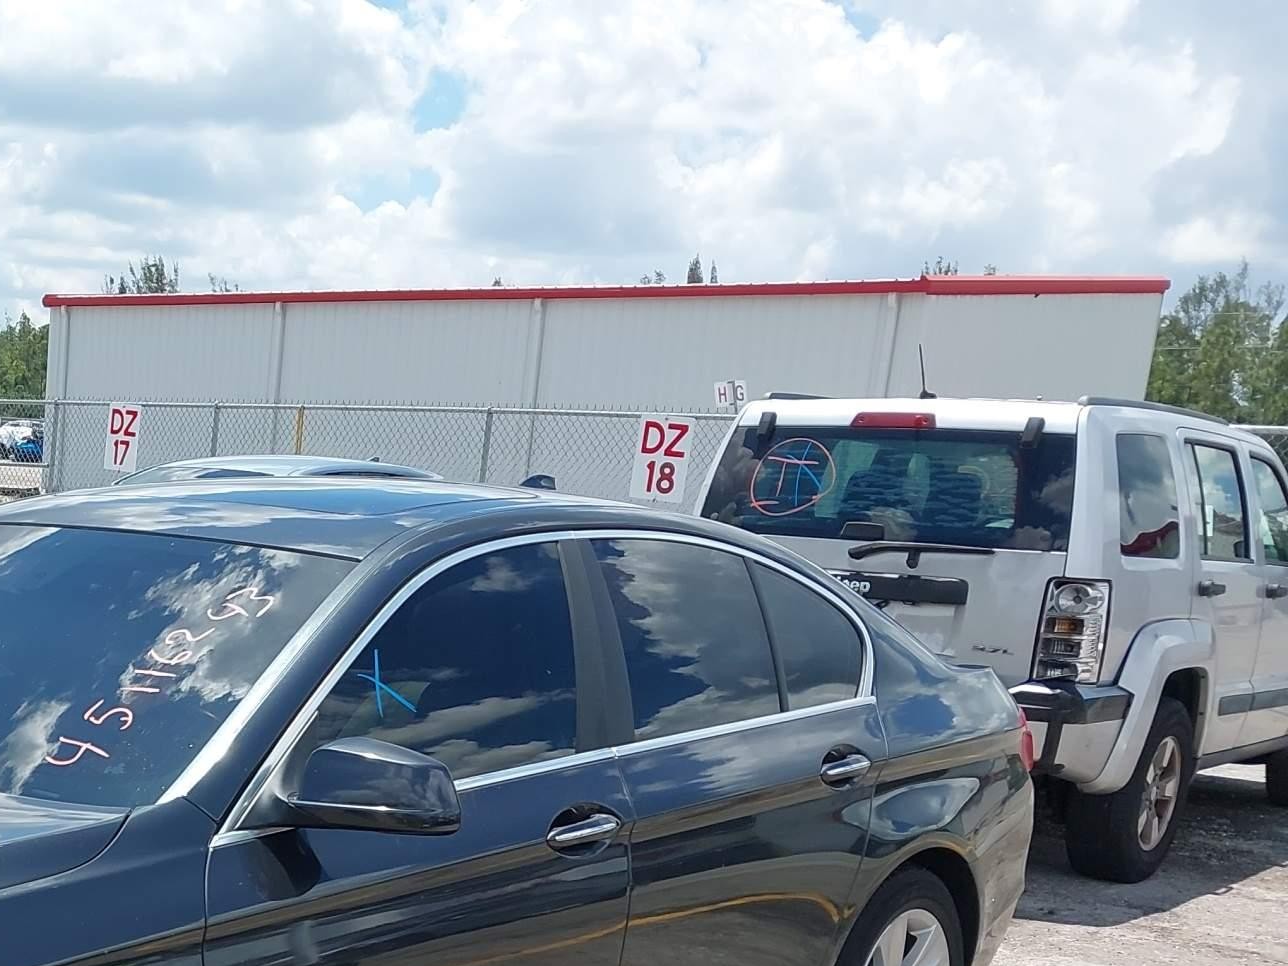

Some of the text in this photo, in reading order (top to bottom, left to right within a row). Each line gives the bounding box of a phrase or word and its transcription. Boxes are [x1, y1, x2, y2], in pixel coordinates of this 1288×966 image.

[717, 386, 728, 403] H
[735, 384, 745, 401] G
[110, 408, 138, 438] DZ
[113, 439, 130, 466] 17
[640, 420, 690, 459] DZ
[645, 460, 676, 495] 18
